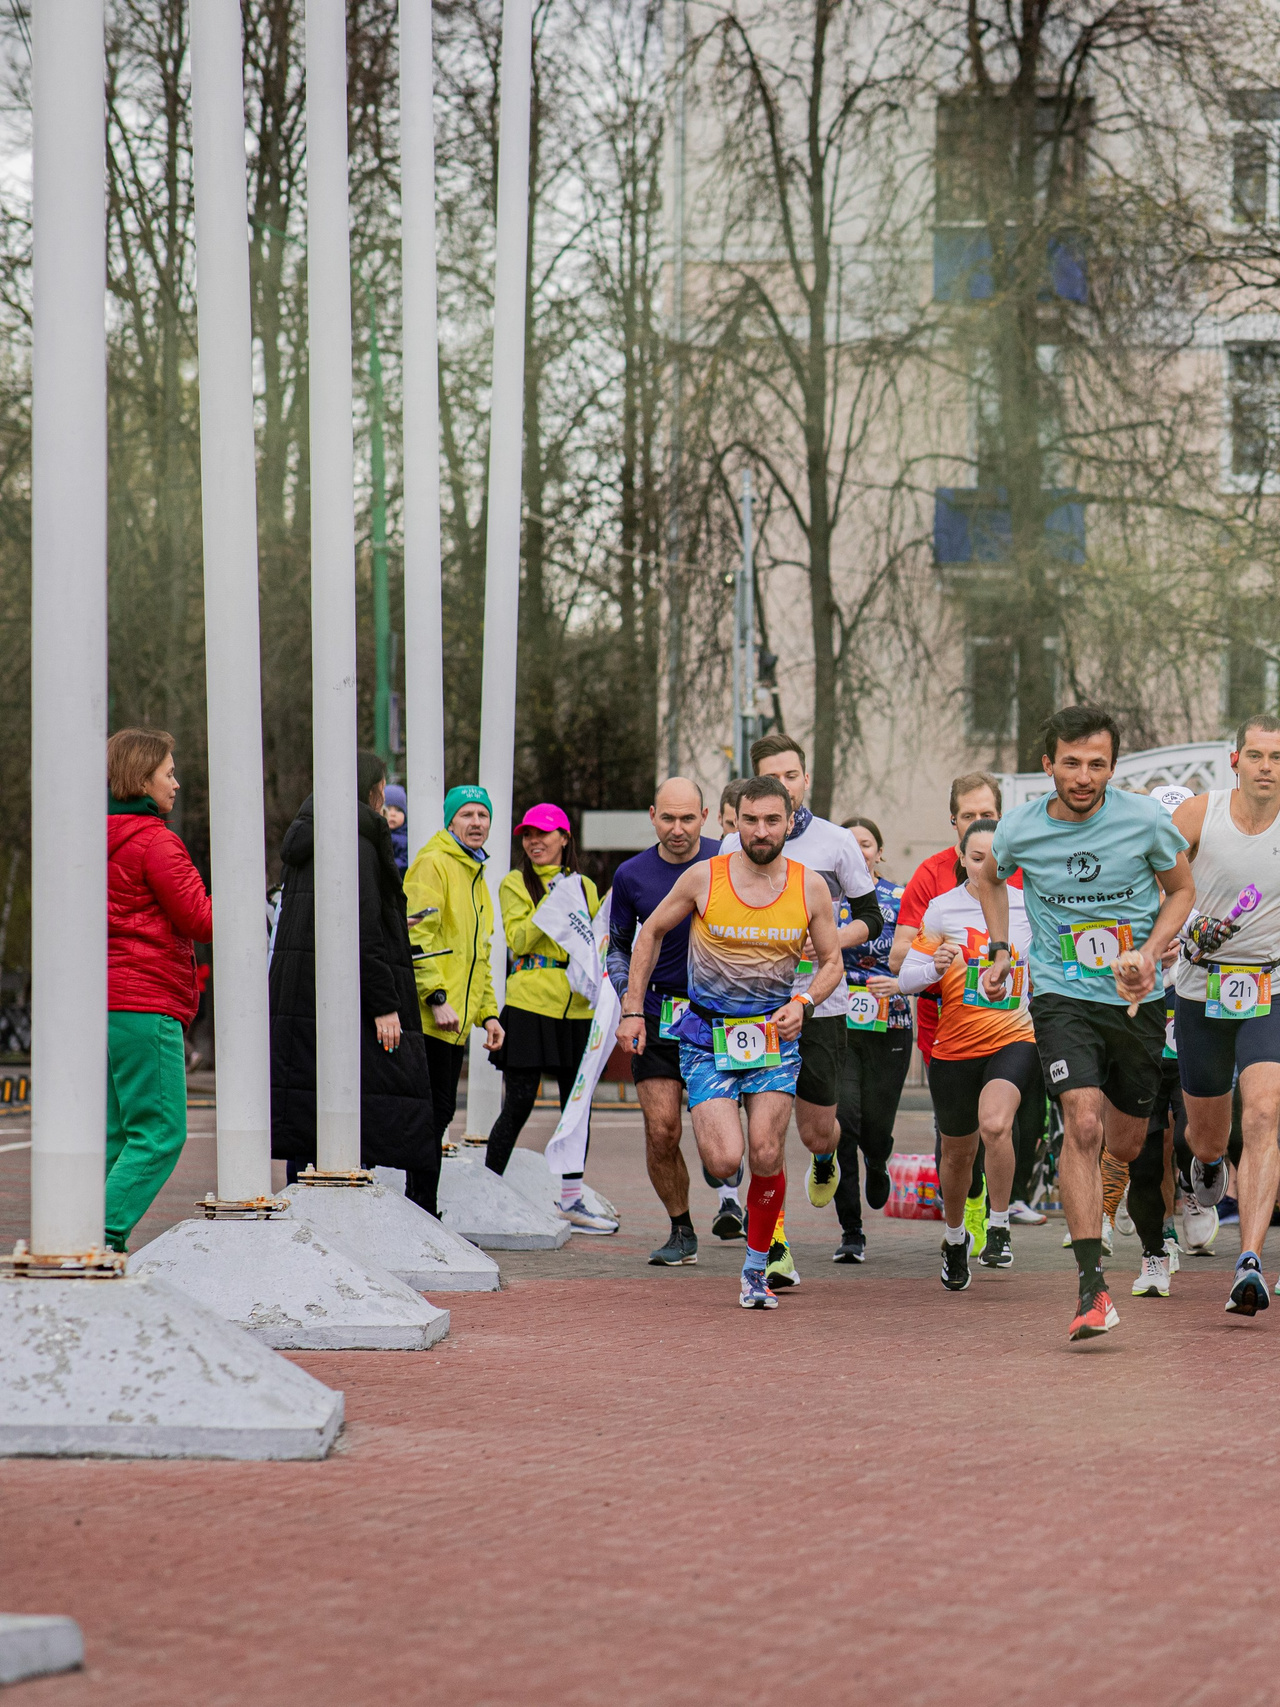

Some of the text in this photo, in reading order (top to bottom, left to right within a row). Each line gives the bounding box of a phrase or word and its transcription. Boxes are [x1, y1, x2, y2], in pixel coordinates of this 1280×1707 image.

[1066, 851, 1099, 875] RUSSIA RUNNING
[568, 912, 595, 941] DREA
[569, 920, 592, 946] TRAIL
[1228, 980, 1245, 998] 21
[851, 997, 869, 1013] 25
[737, 1031, 748, 1049] 8
